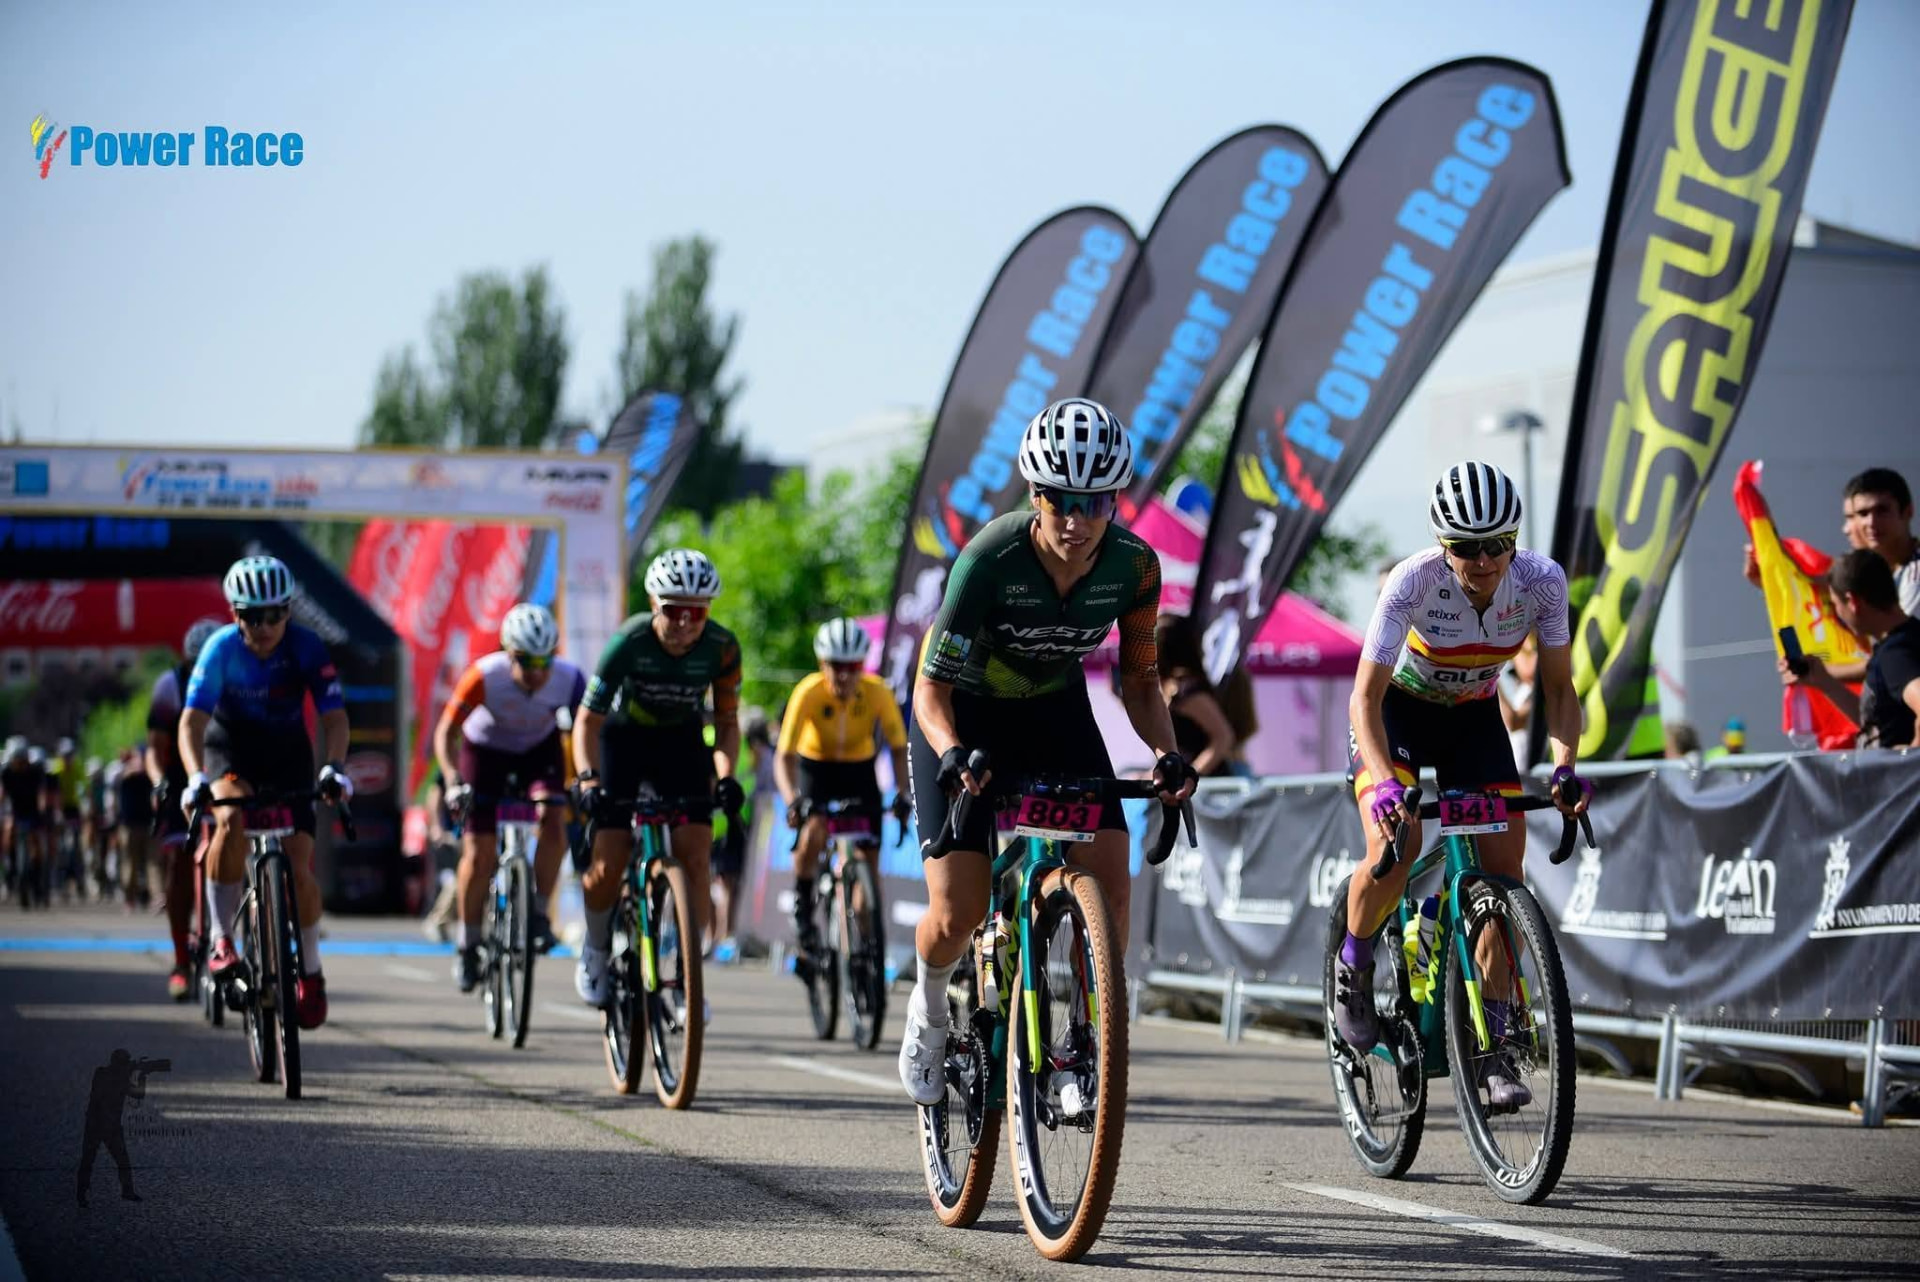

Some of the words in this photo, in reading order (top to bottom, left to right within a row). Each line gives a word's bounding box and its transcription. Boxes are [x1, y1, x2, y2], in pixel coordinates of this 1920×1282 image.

[1196, 145, 1312, 294] Race
[1286, 242, 1435, 462] Power
[1395, 82, 1536, 251] Race
[948, 352, 1059, 524] Power
[1026, 225, 1127, 359] Race
[1427, 608, 1457, 622] etixx
[1027, 800, 1089, 829] 803
